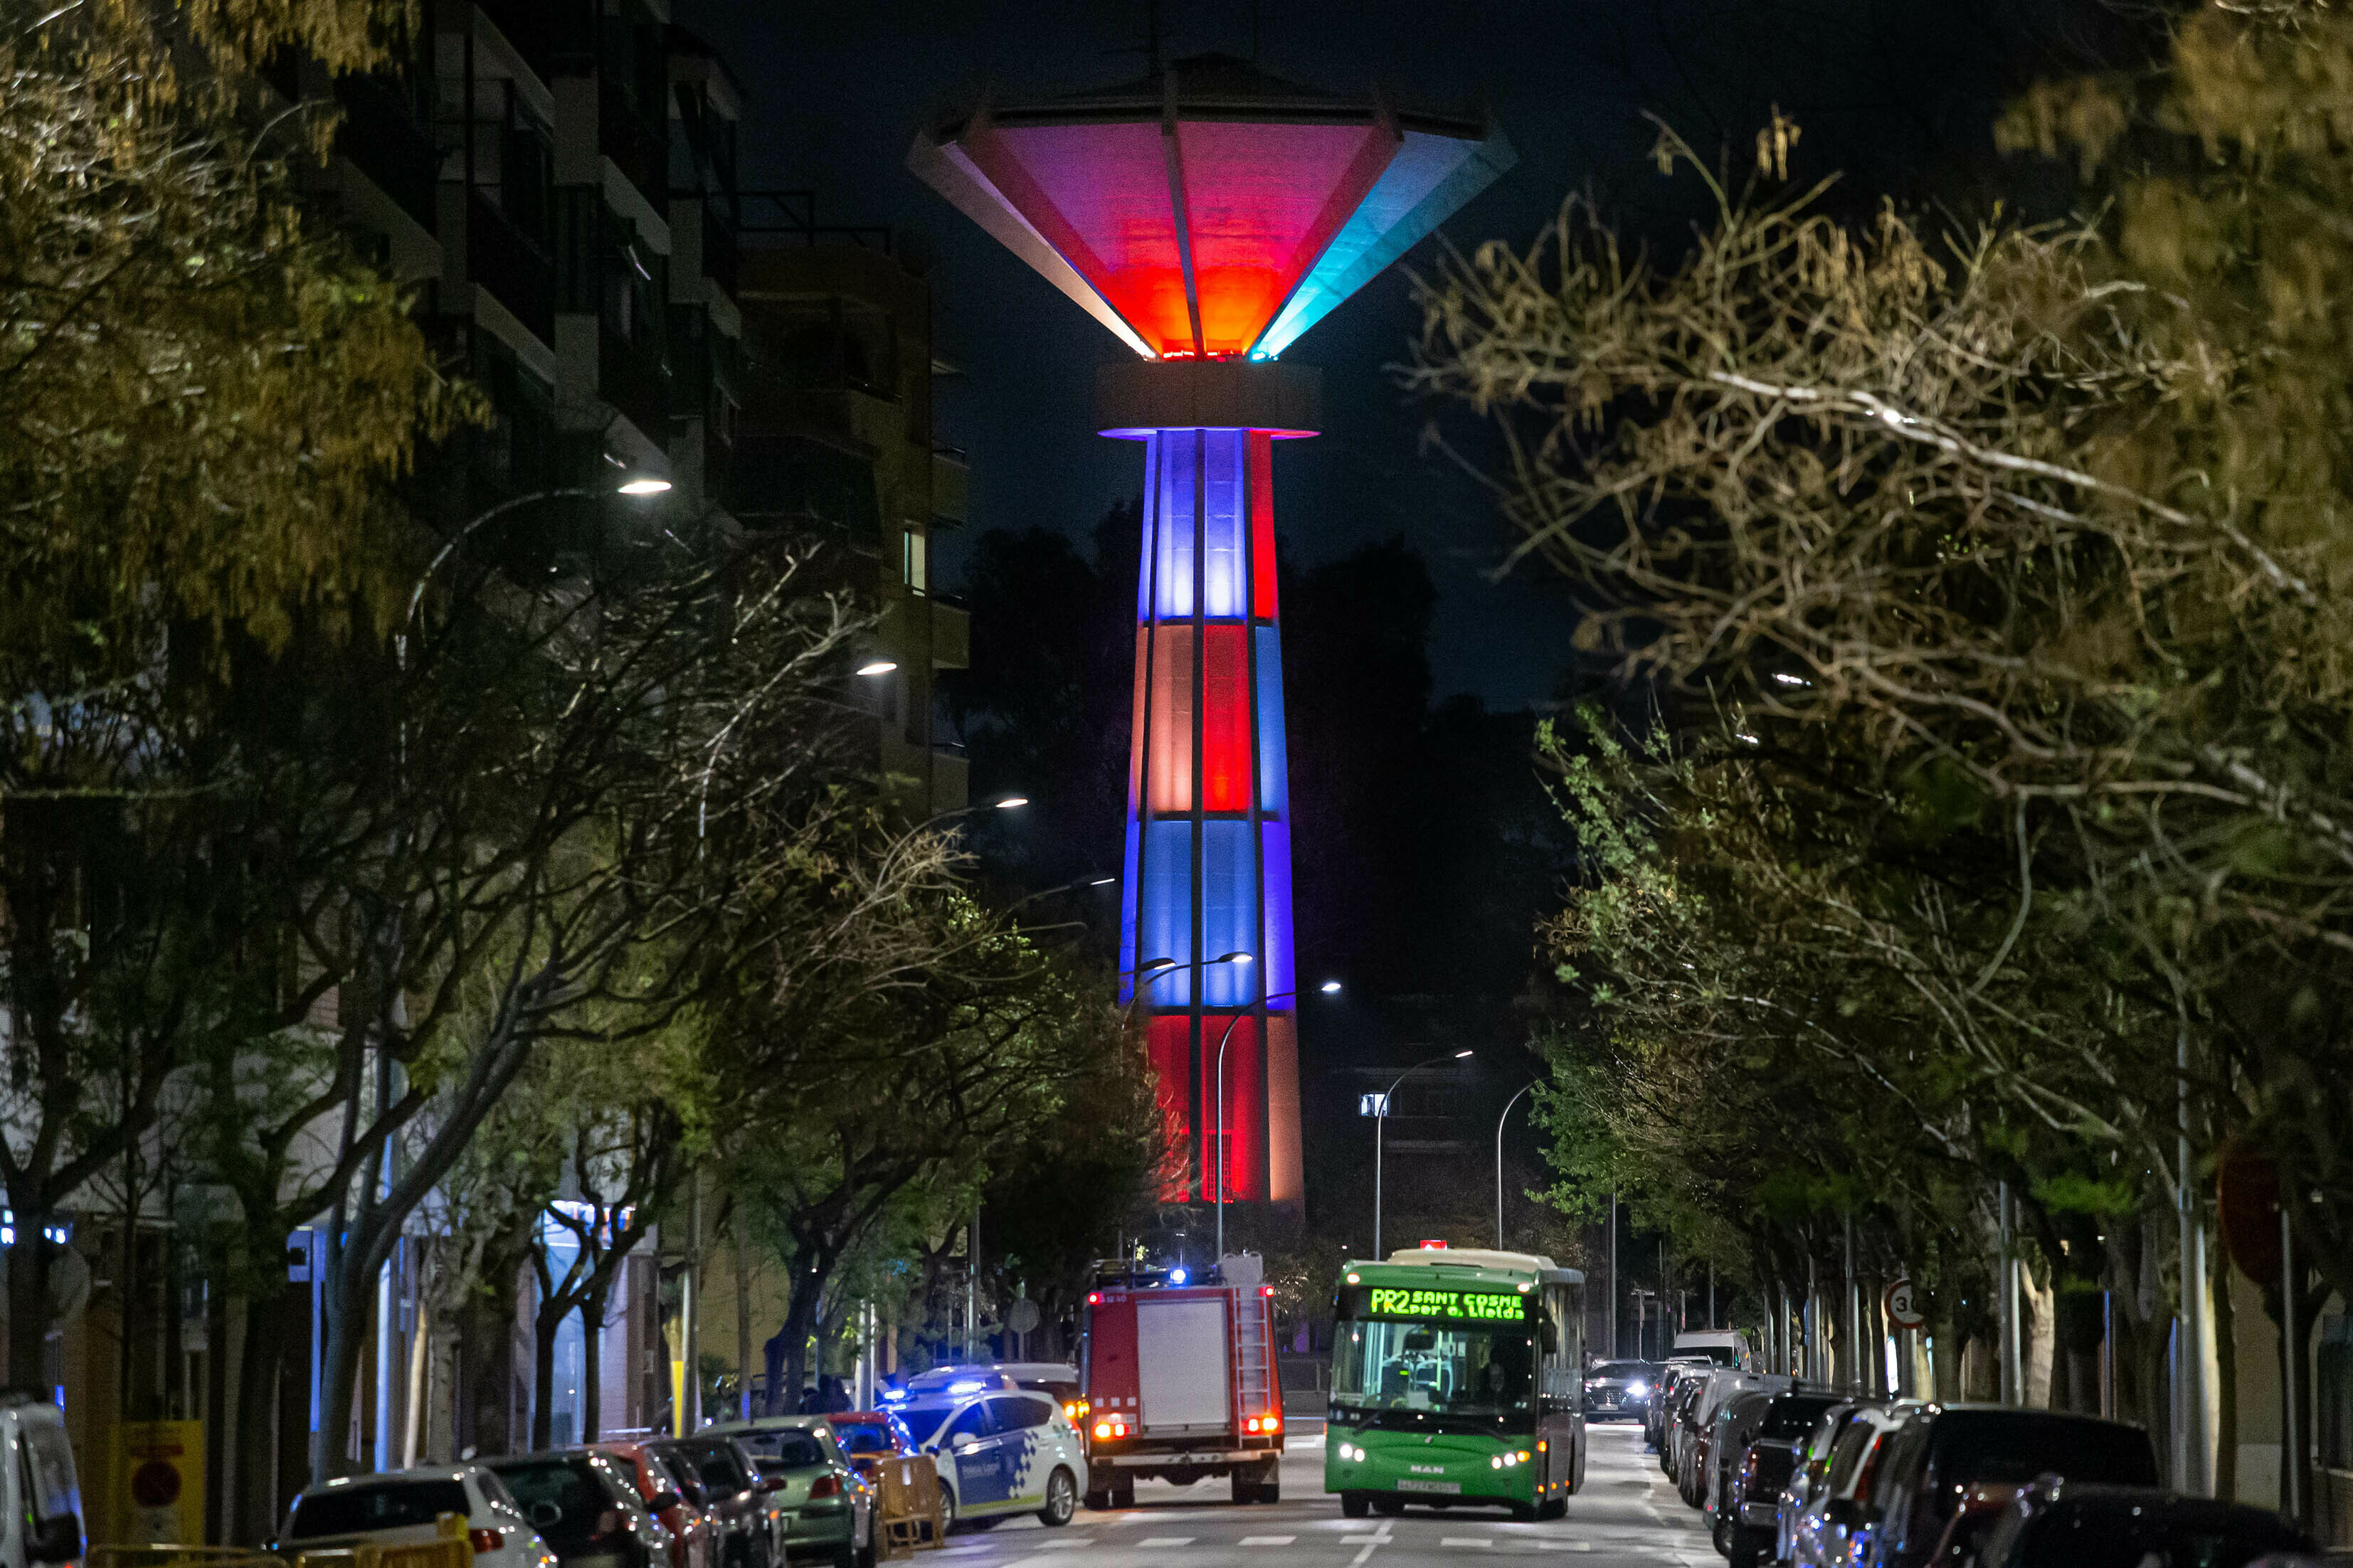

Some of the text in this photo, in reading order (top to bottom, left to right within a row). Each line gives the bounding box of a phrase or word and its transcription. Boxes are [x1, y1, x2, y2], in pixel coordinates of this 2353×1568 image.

[1371, 1288, 1410, 1314] PR2
[1412, 1291, 1522, 1308] SANT COSME
[1410, 1305, 1442, 1315] per
[1410, 1465, 1444, 1474] MAN
